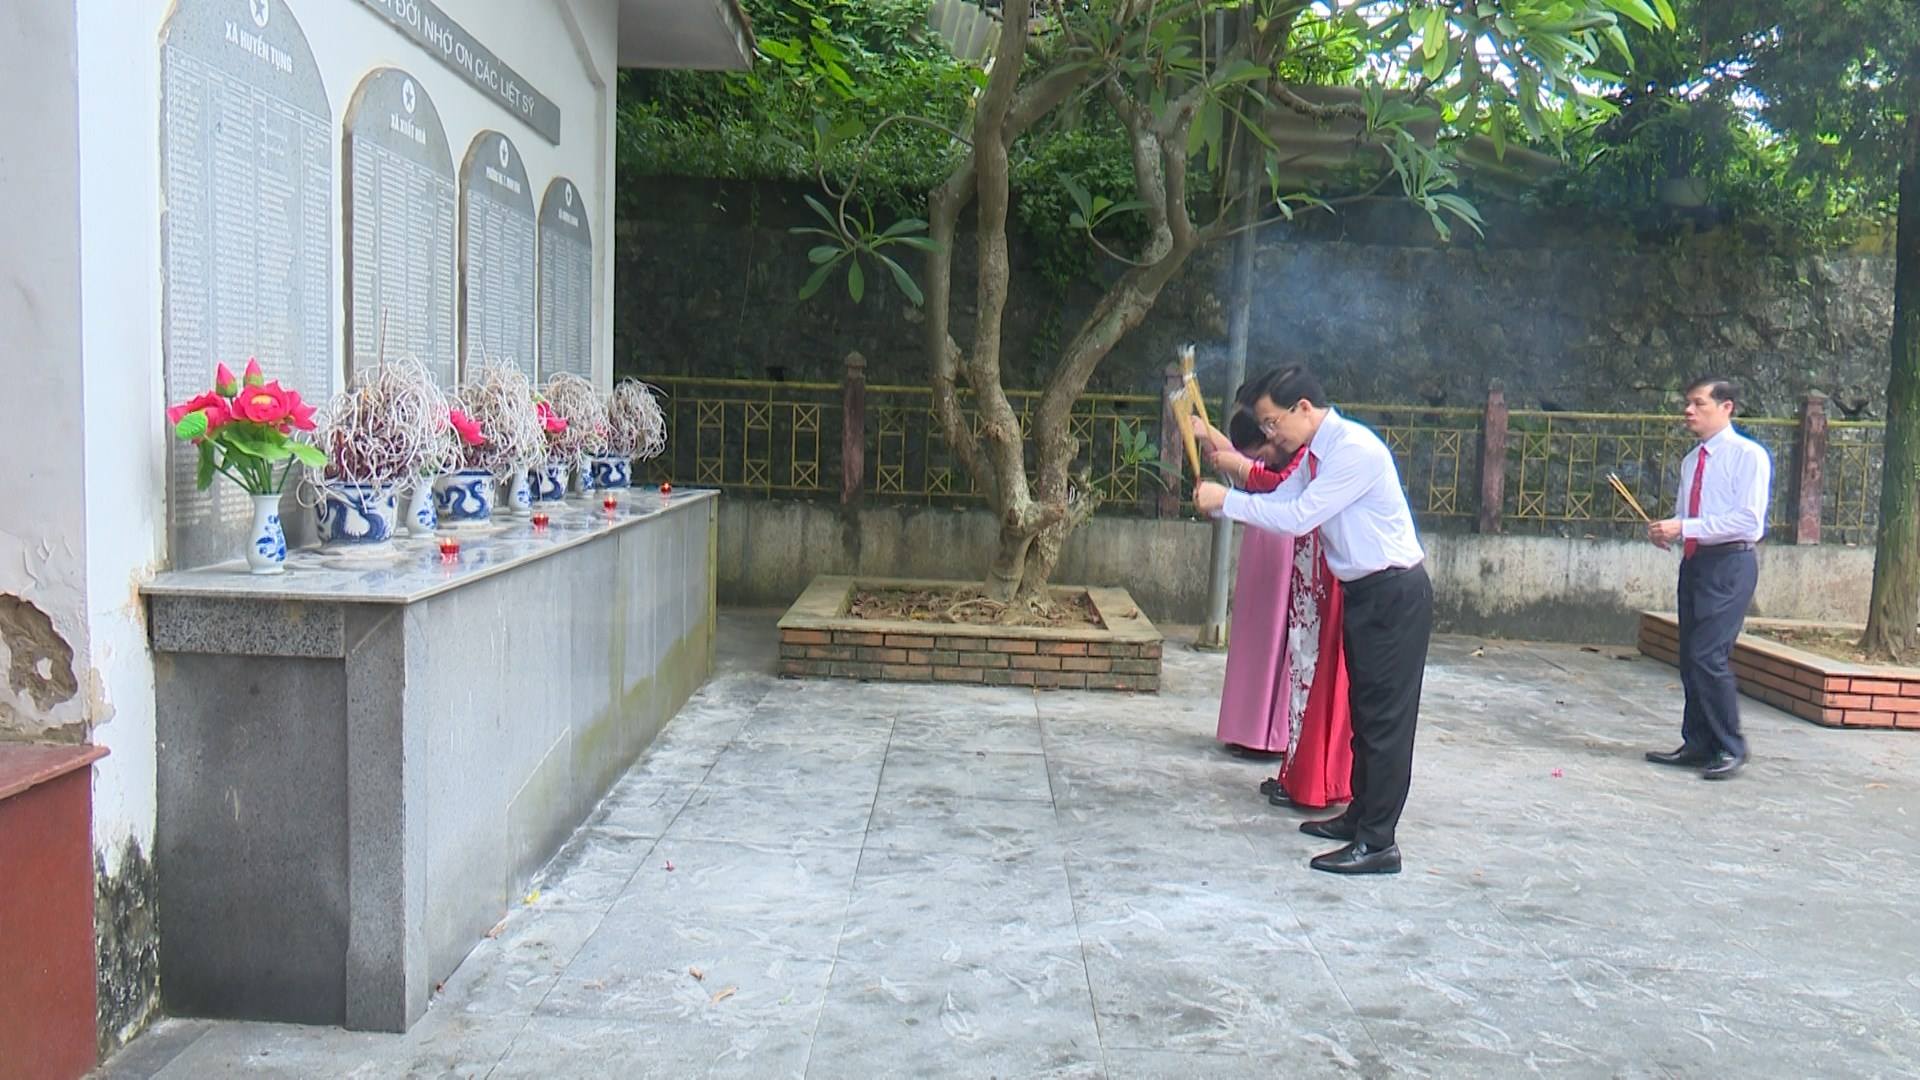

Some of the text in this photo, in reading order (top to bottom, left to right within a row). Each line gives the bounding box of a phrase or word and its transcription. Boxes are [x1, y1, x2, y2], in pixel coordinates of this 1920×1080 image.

[455, 42, 473, 72] ƠN
[475, 58, 498, 90] CÁC
[500, 76, 521, 108] LIỆT
